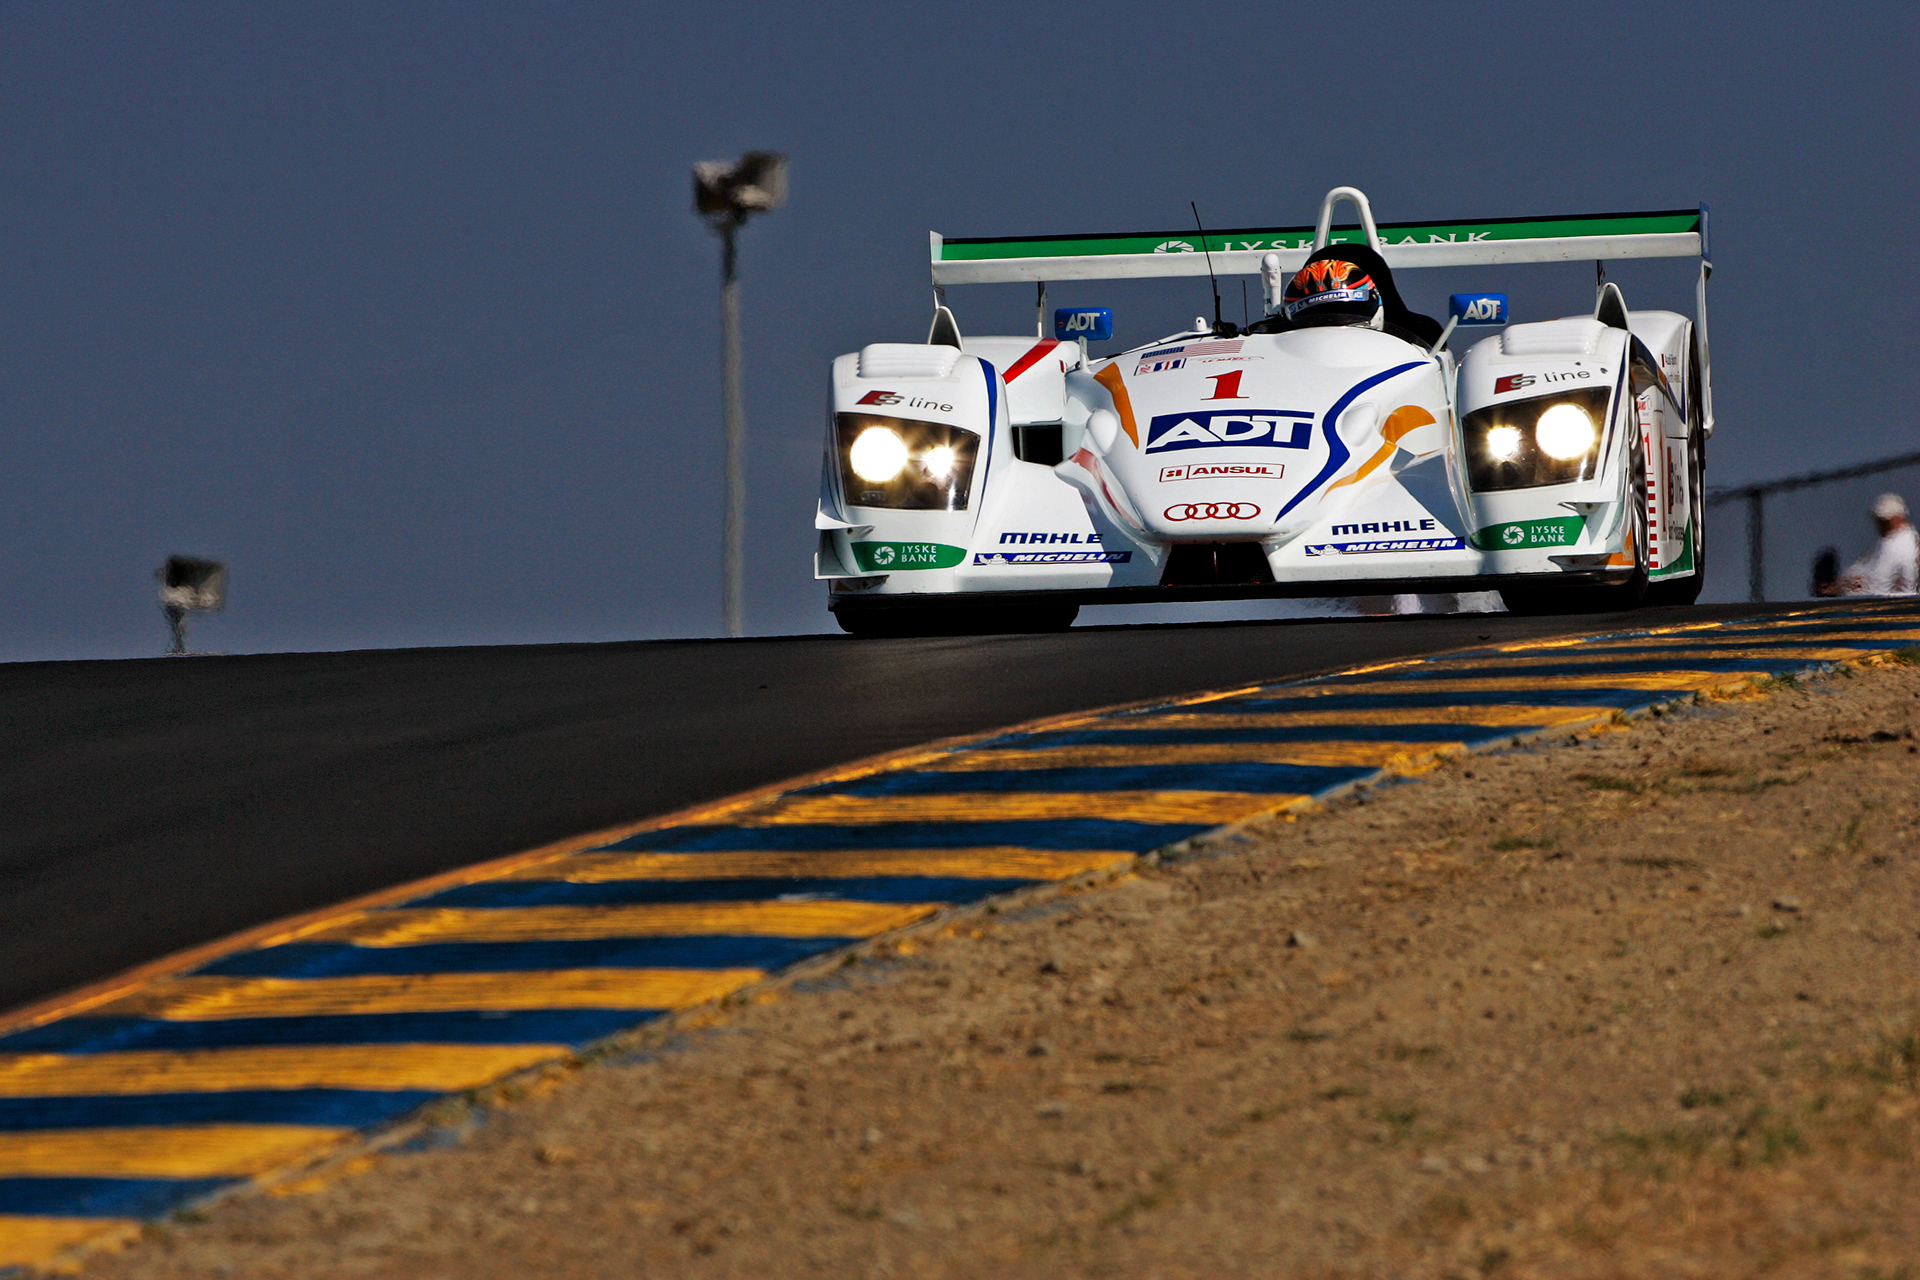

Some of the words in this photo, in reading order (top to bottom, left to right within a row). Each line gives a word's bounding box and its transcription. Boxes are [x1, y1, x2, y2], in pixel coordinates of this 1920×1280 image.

[1308, 292, 1347, 304] MICHELIN
[1462, 298, 1501, 320] ADT
[1065, 312, 1101, 332] ADT
[1544, 371, 1590, 383] line
[1200, 370, 1249, 400] 1
[909, 397, 953, 412] line
[1146, 415, 1314, 449] ADT
[1192, 466, 1273, 475] ANSUL
[1332, 518, 1436, 536] MAHLE
[1000, 533, 1103, 544] MAHLE
[1531, 534, 1566, 543] BANK
[901, 545, 937, 554] JYSKE
[1346, 539, 1458, 552] MICHELIN
[901, 554, 937, 563] BANK
[1013, 553, 1124, 563] MICHELIN
